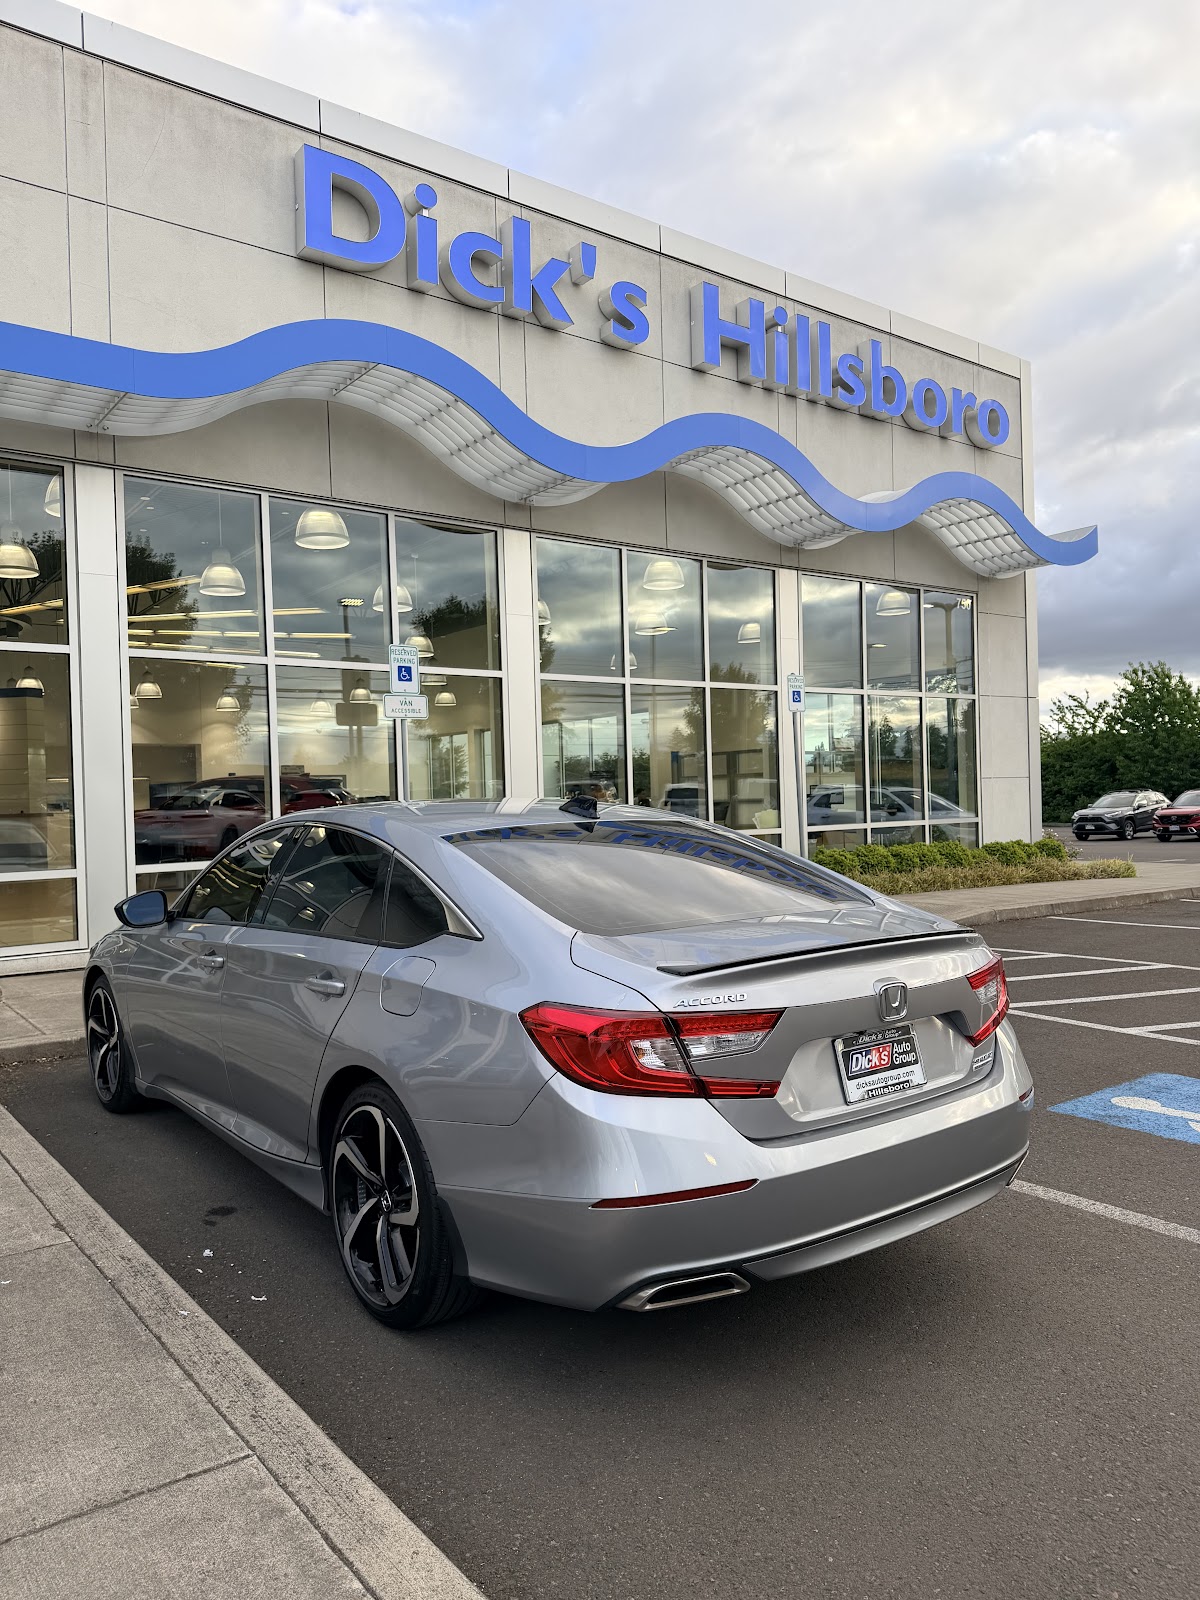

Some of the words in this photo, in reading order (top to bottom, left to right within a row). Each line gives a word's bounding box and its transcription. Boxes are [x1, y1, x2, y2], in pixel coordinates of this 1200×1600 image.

[299, 143, 650, 347] Dick's
[696, 279, 1011, 450] Hillsboro
[391, 648, 417, 657] RESERVED
[393, 657, 416, 665] PARKING
[673, 993, 748, 1009] ACCORD
[892, 1043, 911, 1054] Auto
[851, 1047, 889, 1072] Dick's
[893, 1051, 916, 1065] Group
[856, 1070, 916, 1090] dicksautogroup.com
[868, 1082, 910, 1098] Hillsboro
